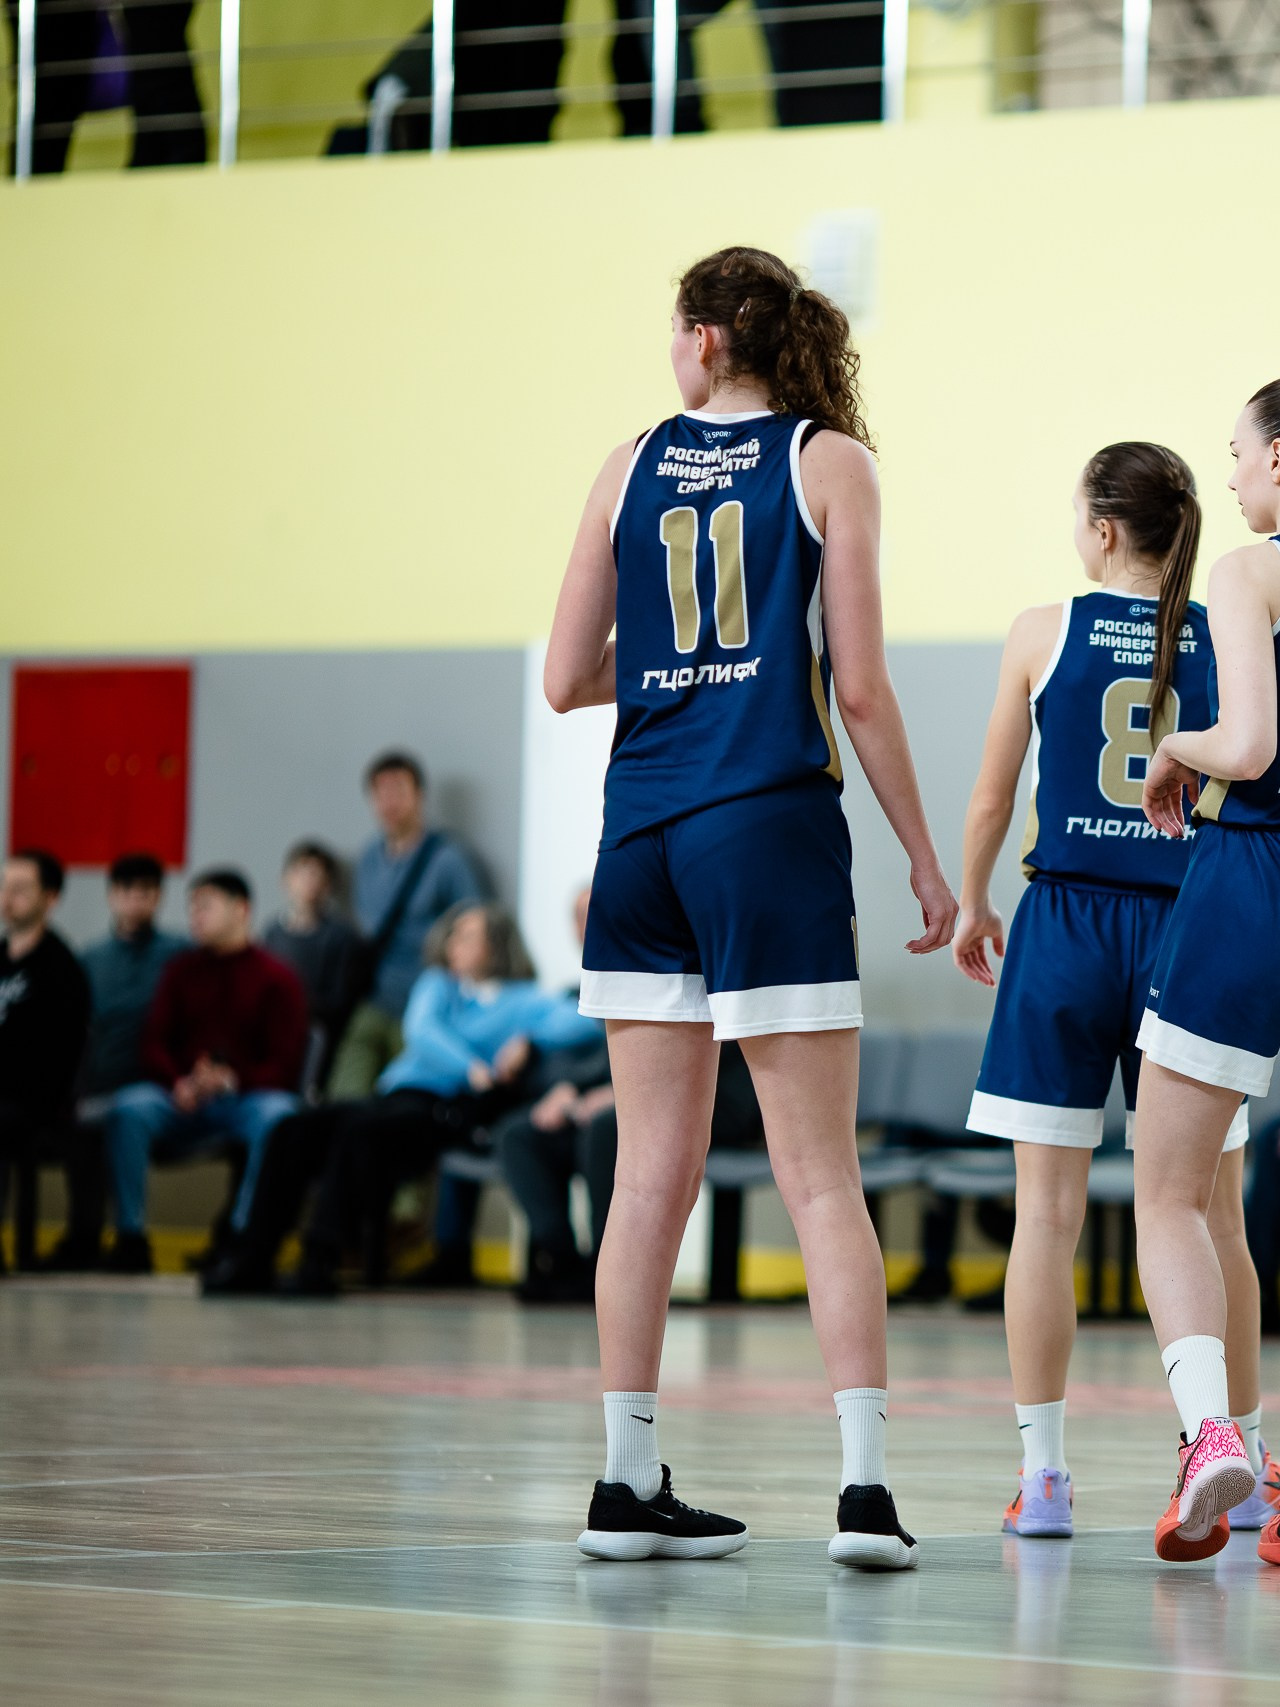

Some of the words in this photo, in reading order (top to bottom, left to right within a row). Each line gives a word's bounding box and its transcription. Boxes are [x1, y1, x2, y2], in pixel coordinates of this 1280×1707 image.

[677, 474, 732, 494] СПОРТА
[659, 500, 750, 654] 11
[641, 657, 761, 691] ГЦОЛИФК
[1114, 651, 1154, 665] СПОР
[1098, 677, 1180, 808] 8
